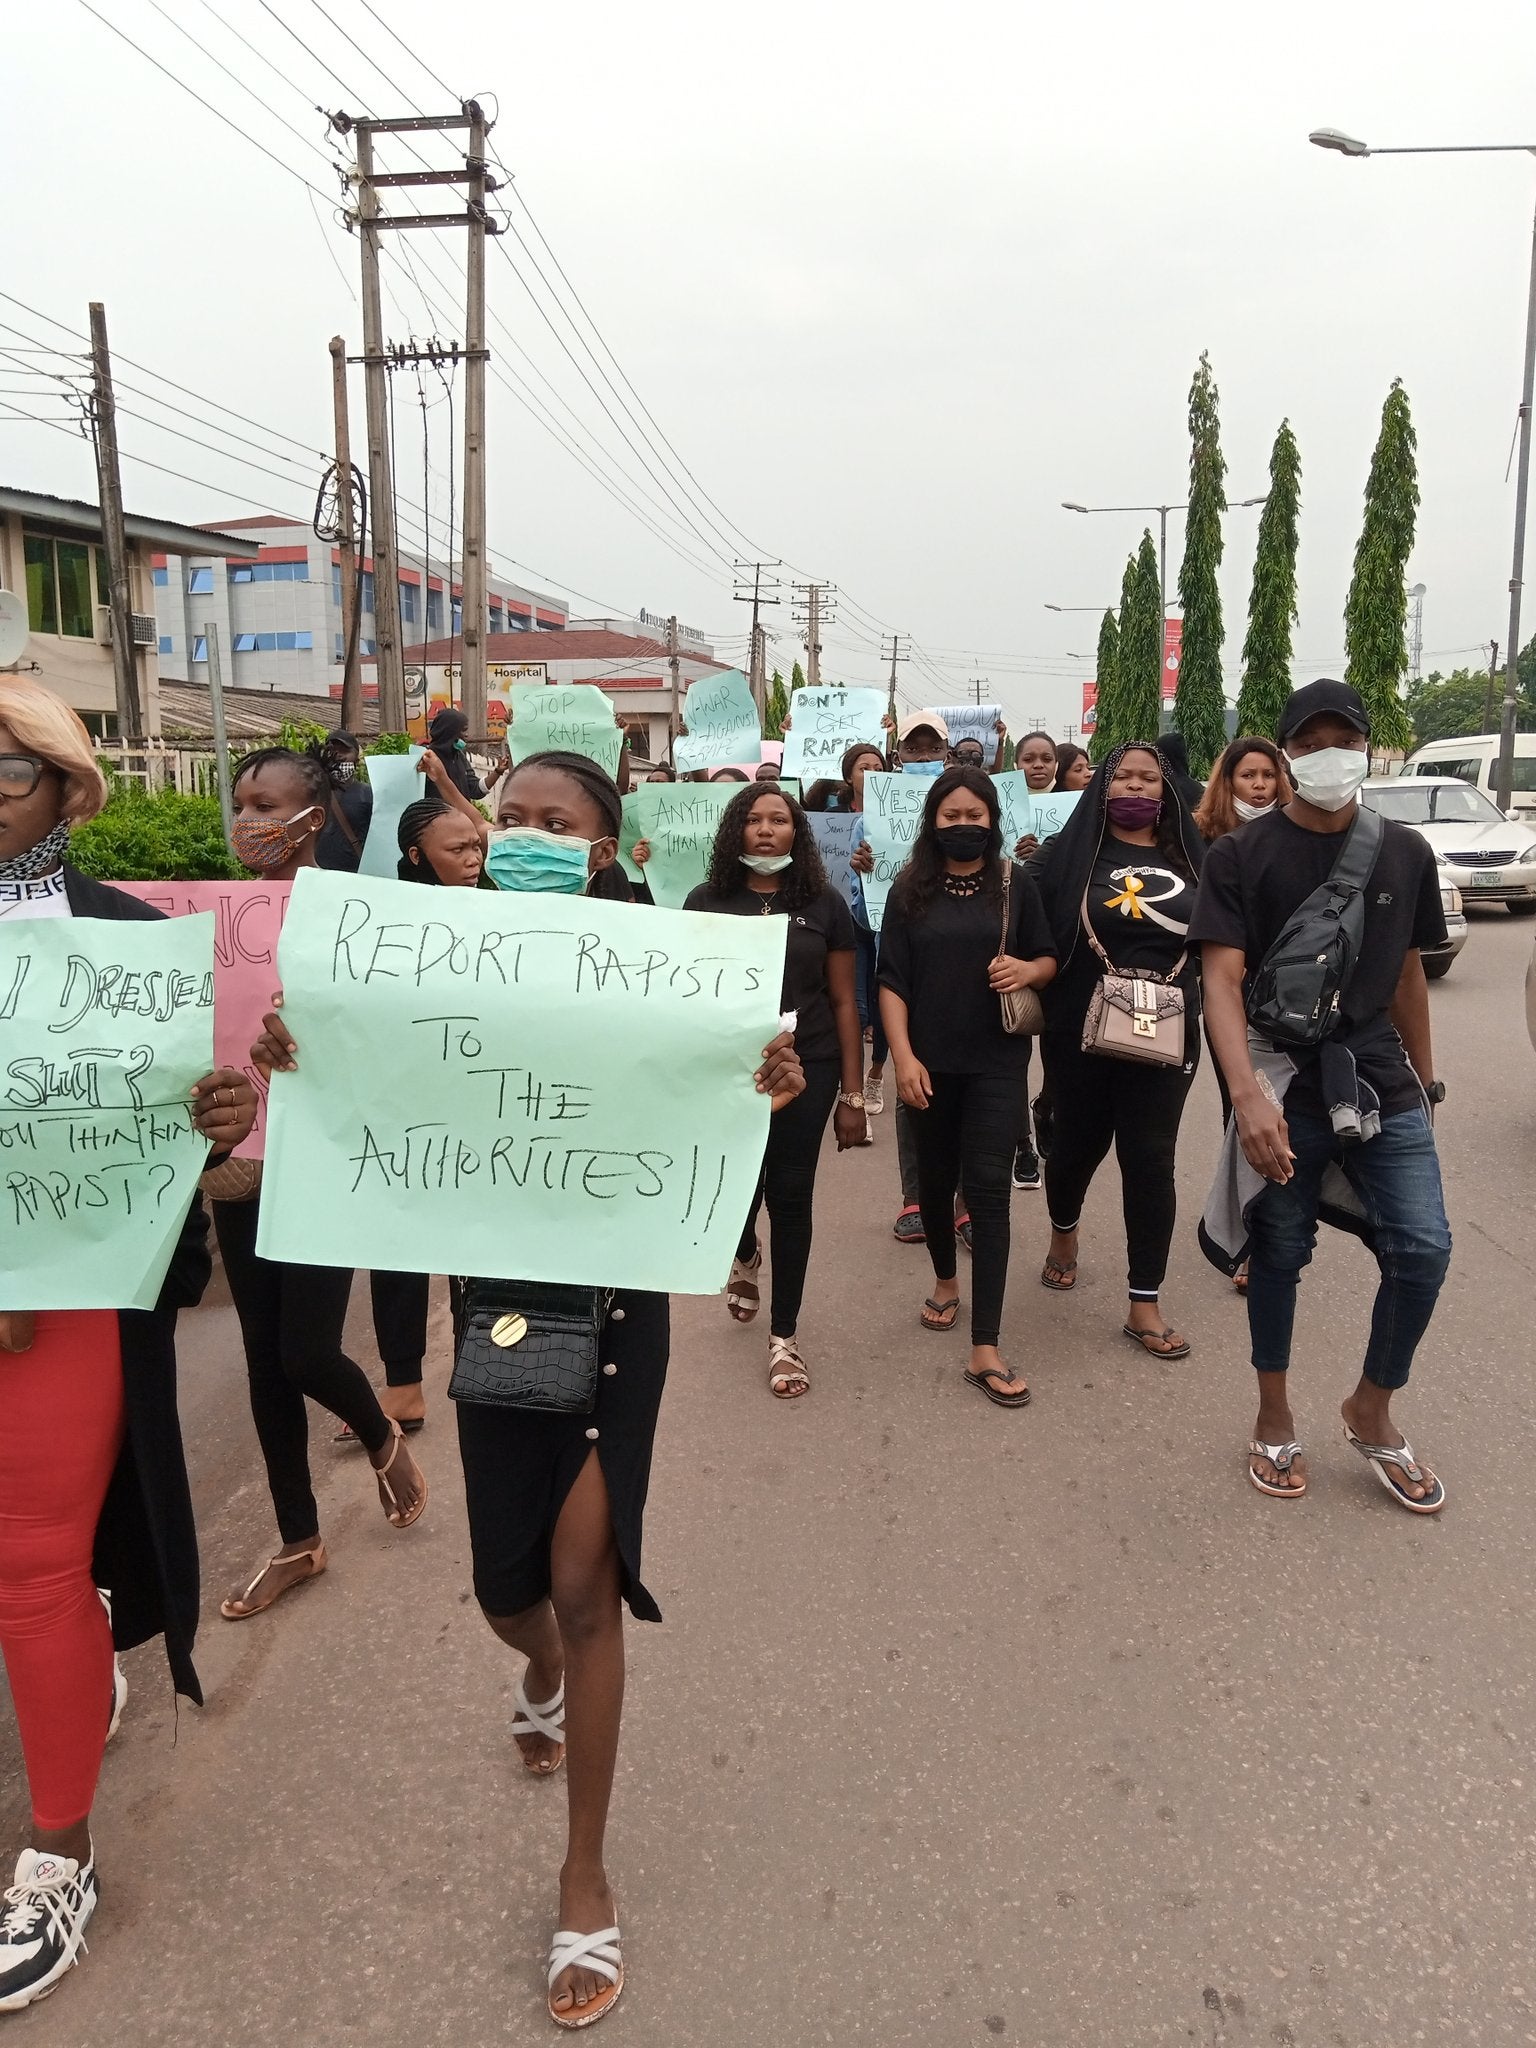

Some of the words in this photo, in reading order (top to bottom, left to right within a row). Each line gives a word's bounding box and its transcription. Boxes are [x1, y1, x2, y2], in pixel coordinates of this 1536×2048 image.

[494, 668, 542, 679] Hospital
[523, 693, 576, 722] STOP
[797, 692, 848, 708] DON'T
[547, 721, 596, 745] RAPE
[661, 831, 697, 857] THAN
[333, 900, 574, 986] REPORT
[577, 933, 764, 998] RAPISTS
[412, 1016, 482, 1060] TO
[467, 1068, 593, 1120] THE
[6, 1163, 176, 1225] RAPIST?
